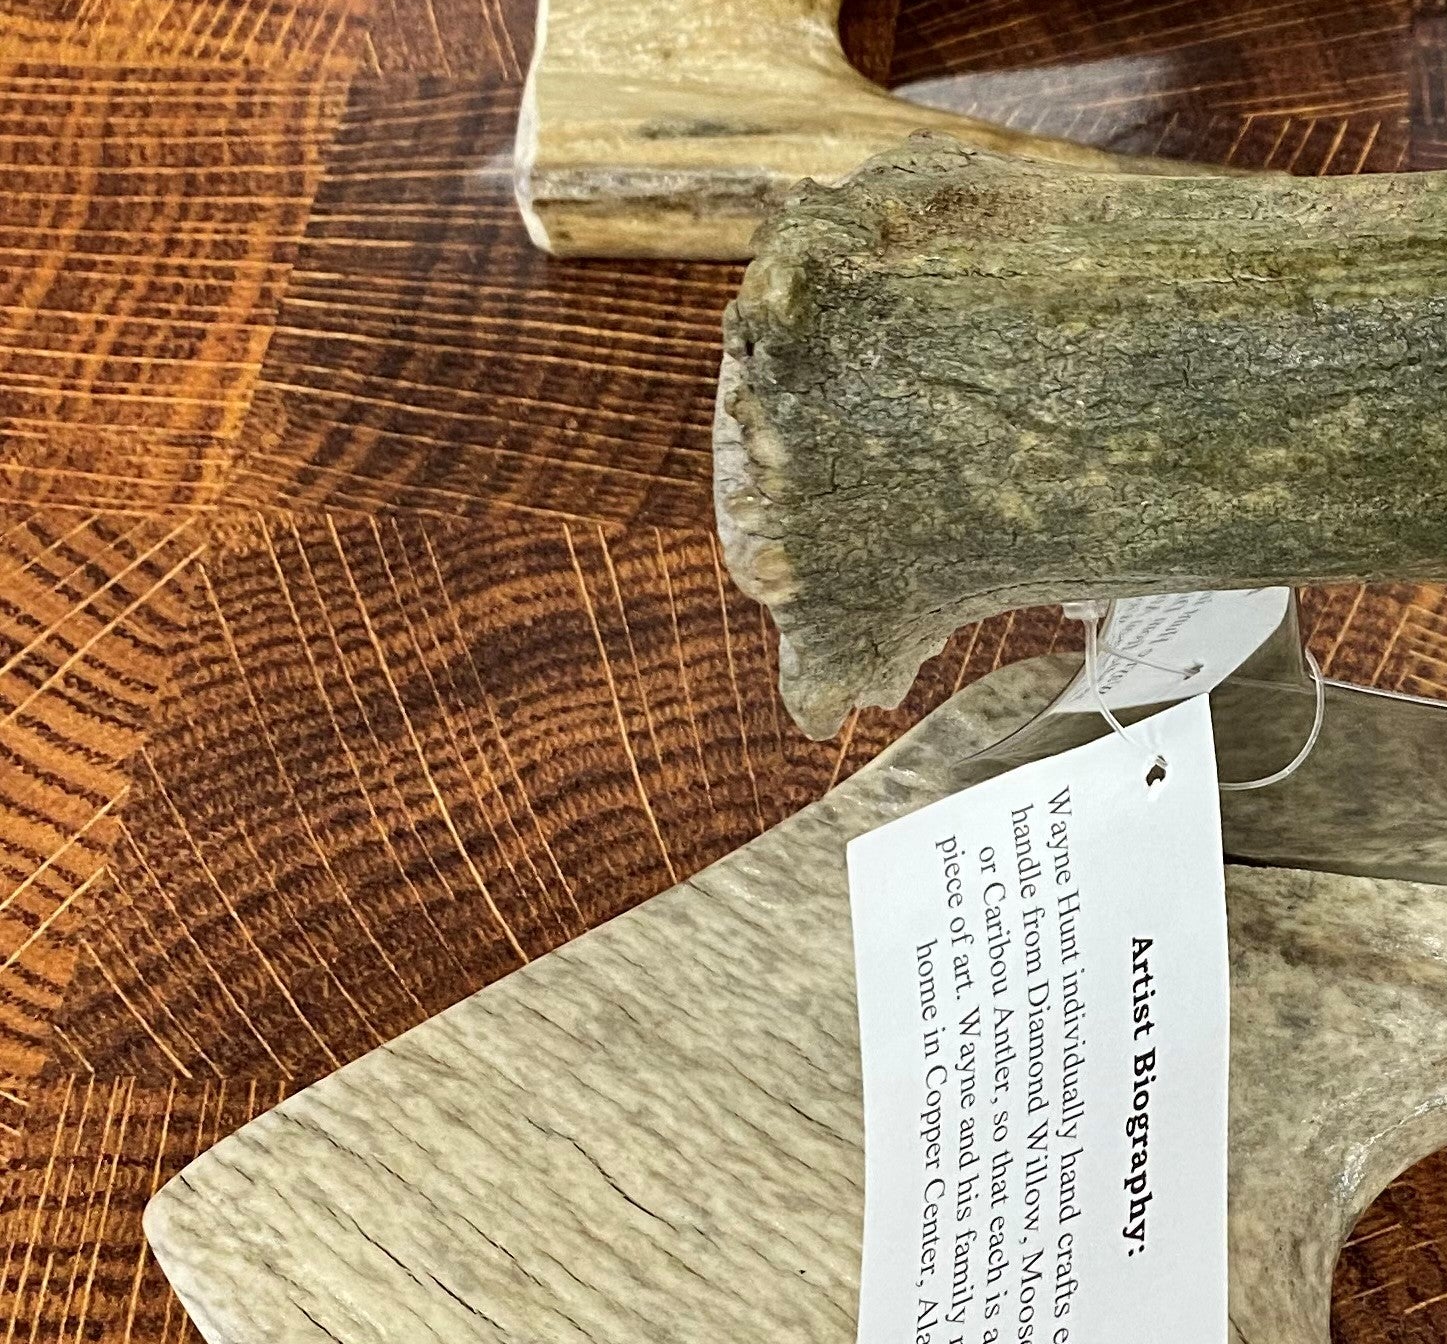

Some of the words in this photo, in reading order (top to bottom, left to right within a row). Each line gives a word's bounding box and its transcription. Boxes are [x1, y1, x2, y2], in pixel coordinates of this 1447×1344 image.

[934, 833, 966, 909] piece
[978, 845, 997, 875] or
[1010, 802, 1043, 900] handle
[1045, 784, 1073, 886] Wayne
[949, 916, 975, 948] of
[982, 881, 1012, 999] Caribou
[1021, 905, 1046, 978] from
[1056, 888, 1081, 966] Hunt
[915, 937, 939, 1022] home
[952, 953, 975, 1001] art.
[1131, 936, 1157, 1042] Artist
[923, 1026, 947, 1060] in
[954, 1004, 982, 1110] Wayne
[989, 1006, 1018, 1105] Antler,
[1027, 978, 1052, 1117] Diamond
[1054, 967, 1087, 1140] individually
[919, 1064, 948, 1171] Copper
[958, 1116, 981, 1172] and
[992, 1110, 1009, 1143] so
[1121, 1045, 1158, 1258] Biography:
[955, 1172, 980, 1222] his
[990, 1148, 1015, 1210] that
[1018, 1117, 1050, 1246] Willow,
[1058, 1146, 1085, 1226] hand
[914, 1177, 946, 1288] Center,
[985, 1215, 1010, 1288] each
[944, 1227, 978, 1325] family
[984, 1289, 1009, 1320] is
[1053, 1232, 1079, 1319] crafts
